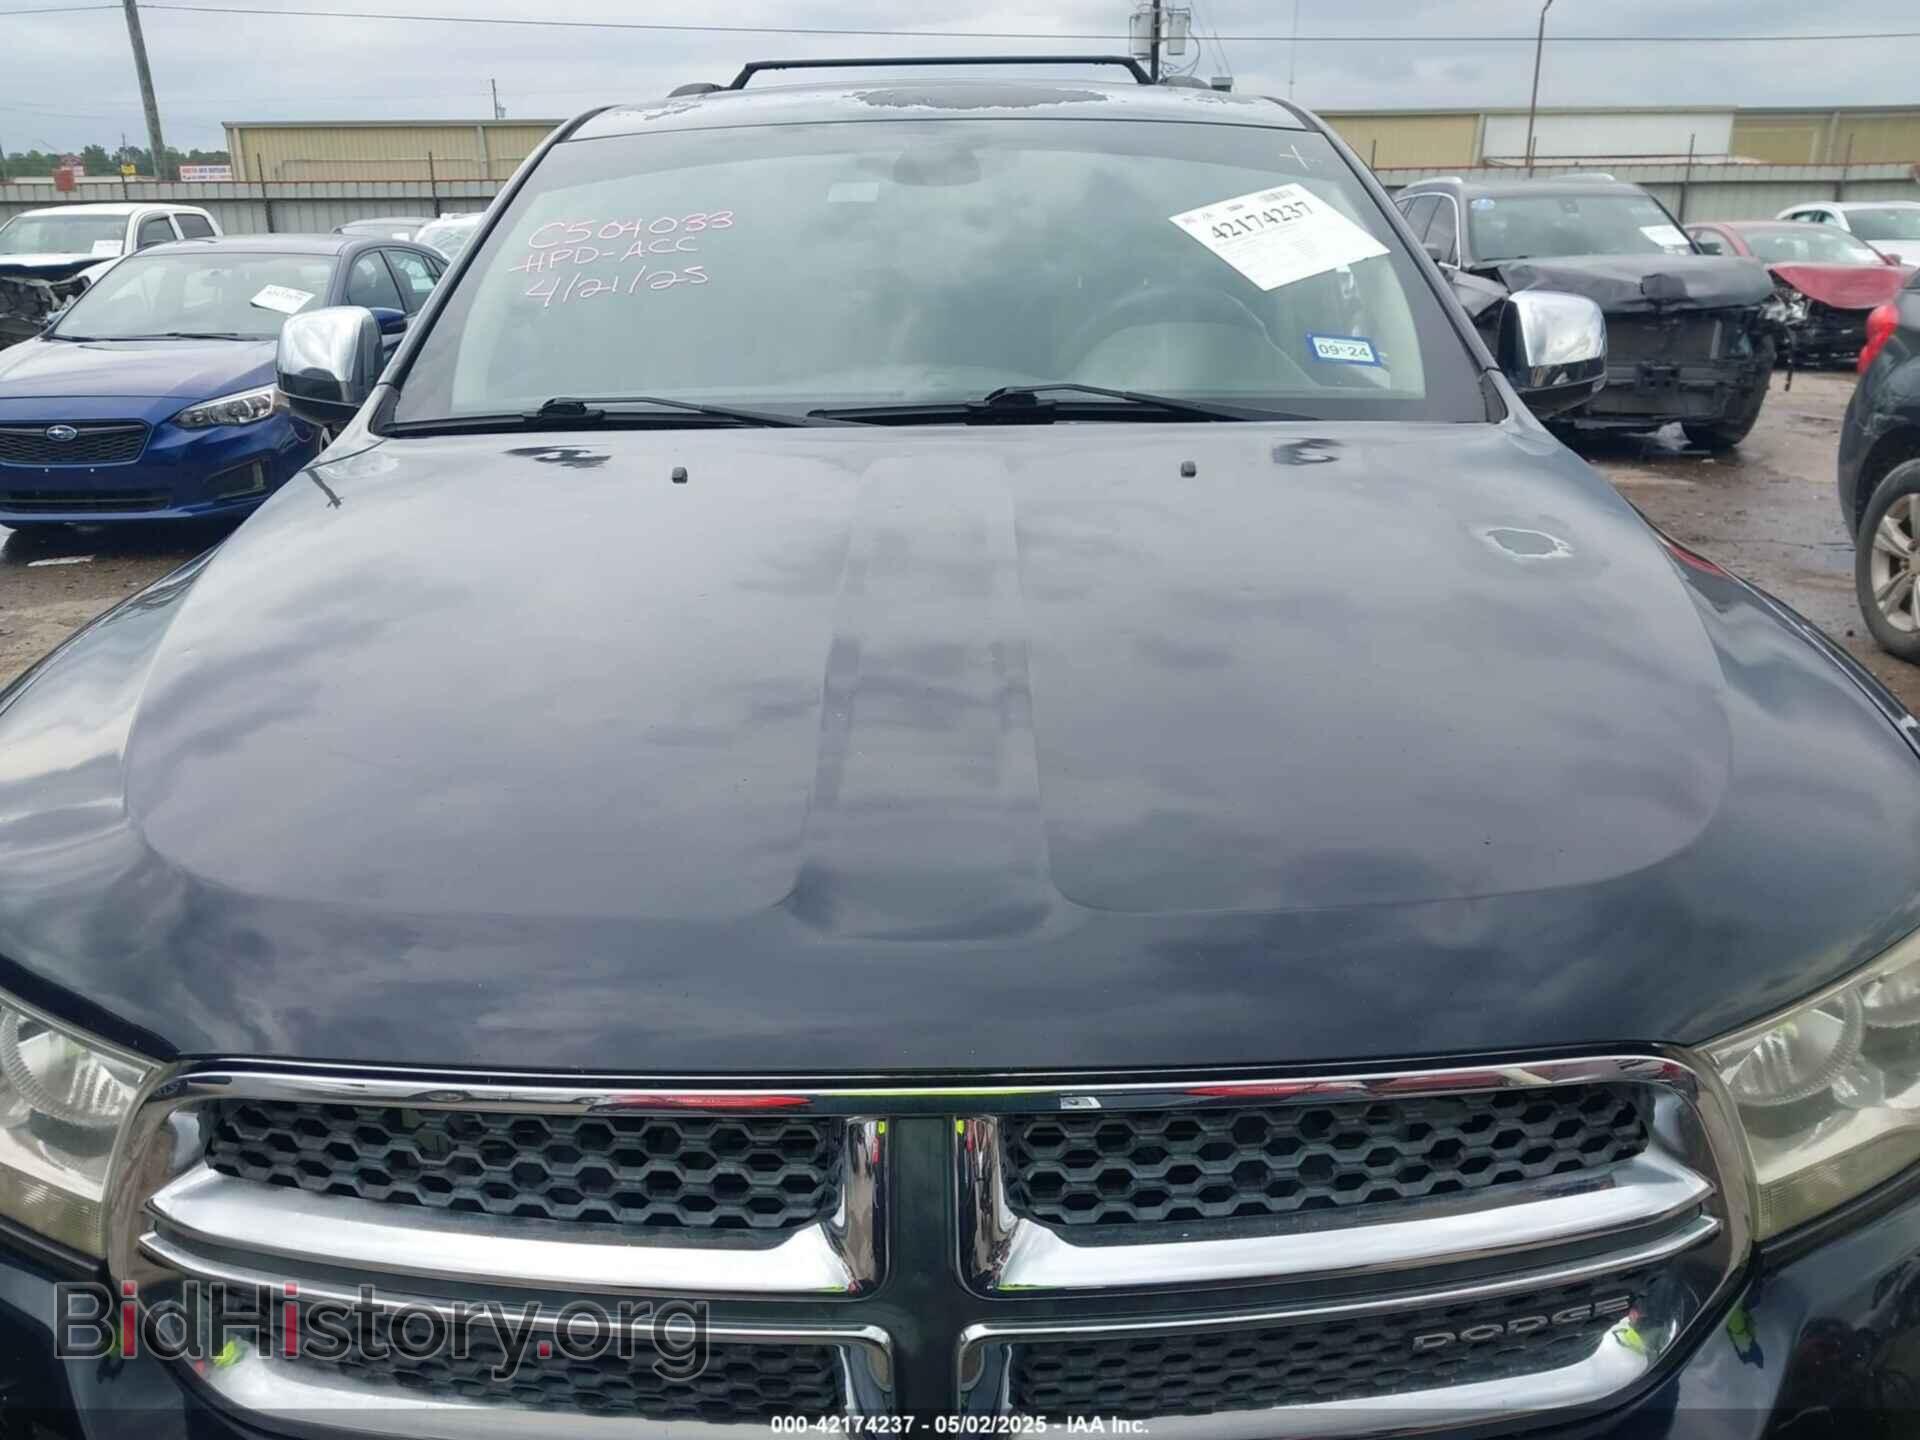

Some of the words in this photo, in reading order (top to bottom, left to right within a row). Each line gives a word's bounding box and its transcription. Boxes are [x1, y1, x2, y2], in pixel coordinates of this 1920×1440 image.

[527, 209, 735, 249] C504033
[1211, 200, 1314, 240] 42174237
[525, 264, 709, 308] 4/21/25
[1412, 1295, 1632, 1351] DODGE
